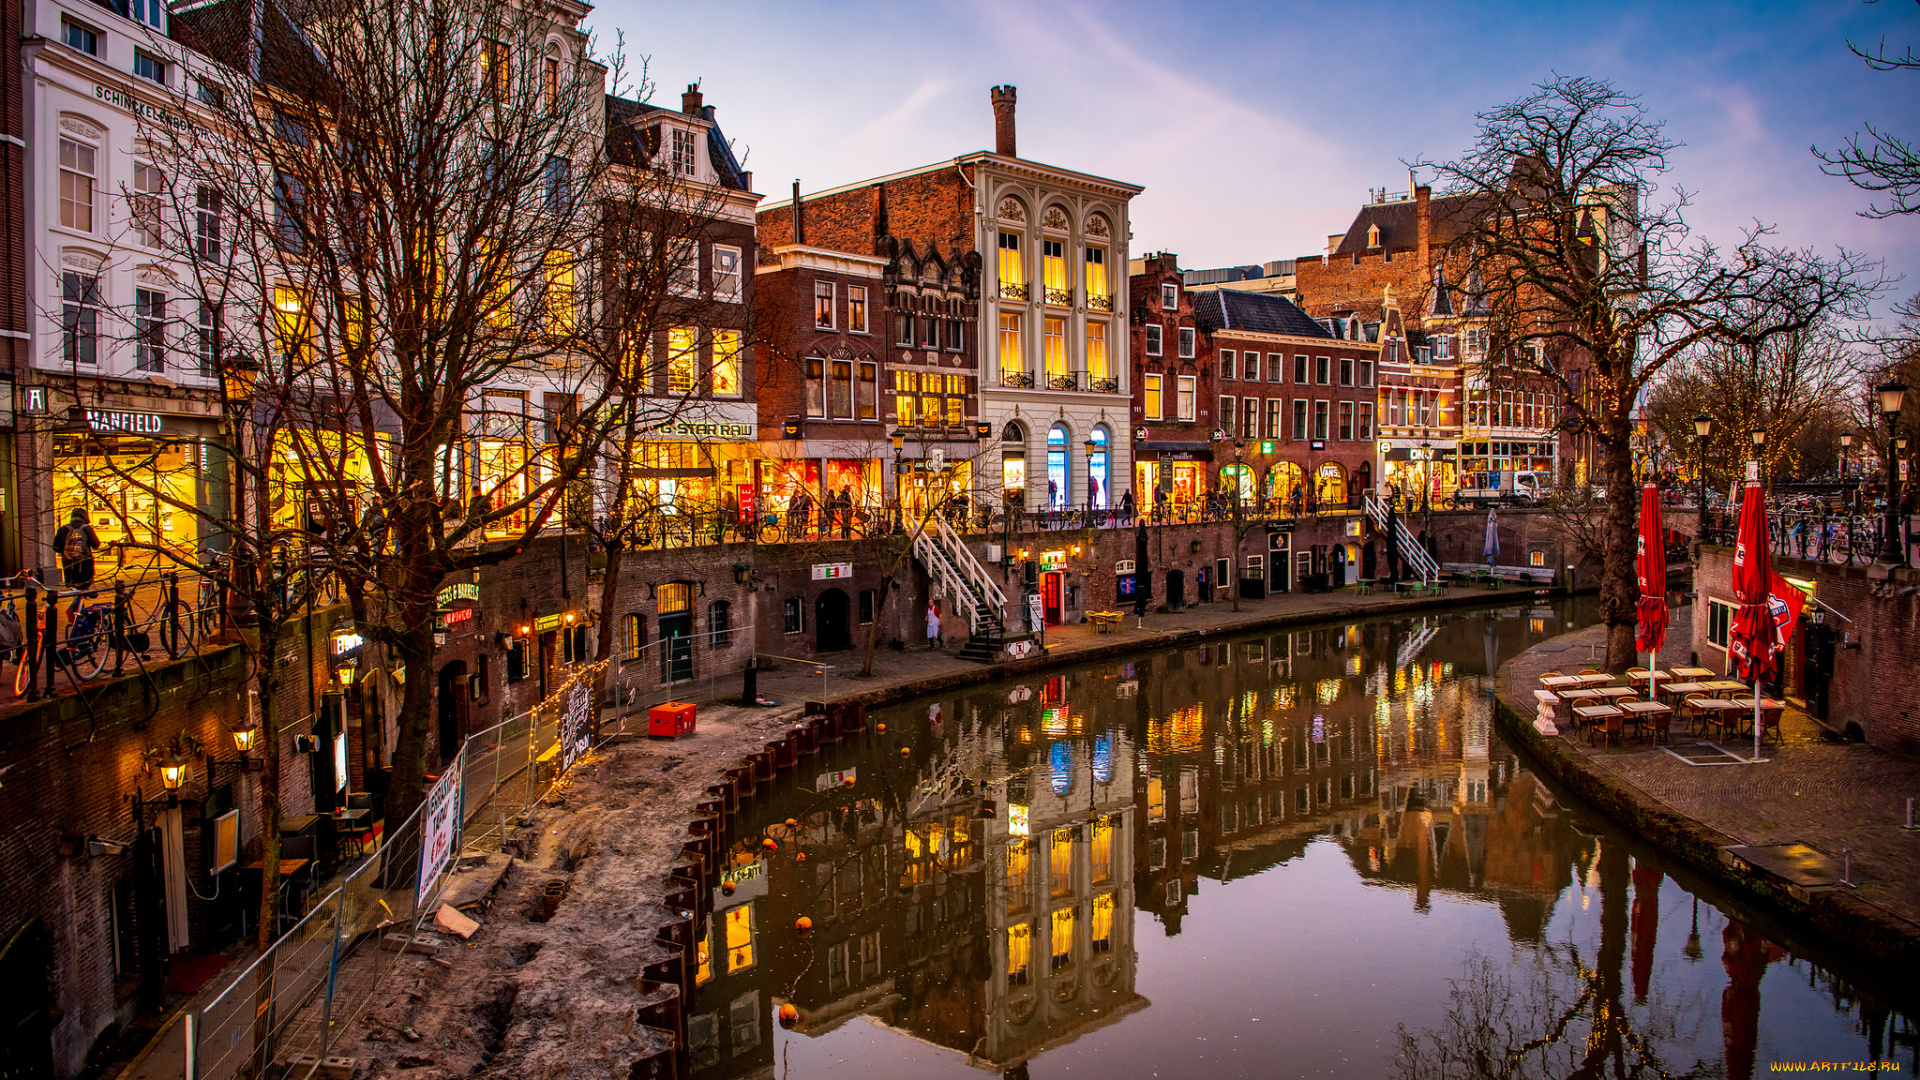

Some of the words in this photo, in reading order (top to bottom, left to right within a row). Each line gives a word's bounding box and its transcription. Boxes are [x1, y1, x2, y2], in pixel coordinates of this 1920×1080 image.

[86, 410, 162, 433] MANFIELD
[718, 424, 752, 437] RAW
[1319, 466, 1338, 478] VANS
[1040, 562, 1068, 571] PIZZERIA
[457, 583, 480, 601] BARRELS
